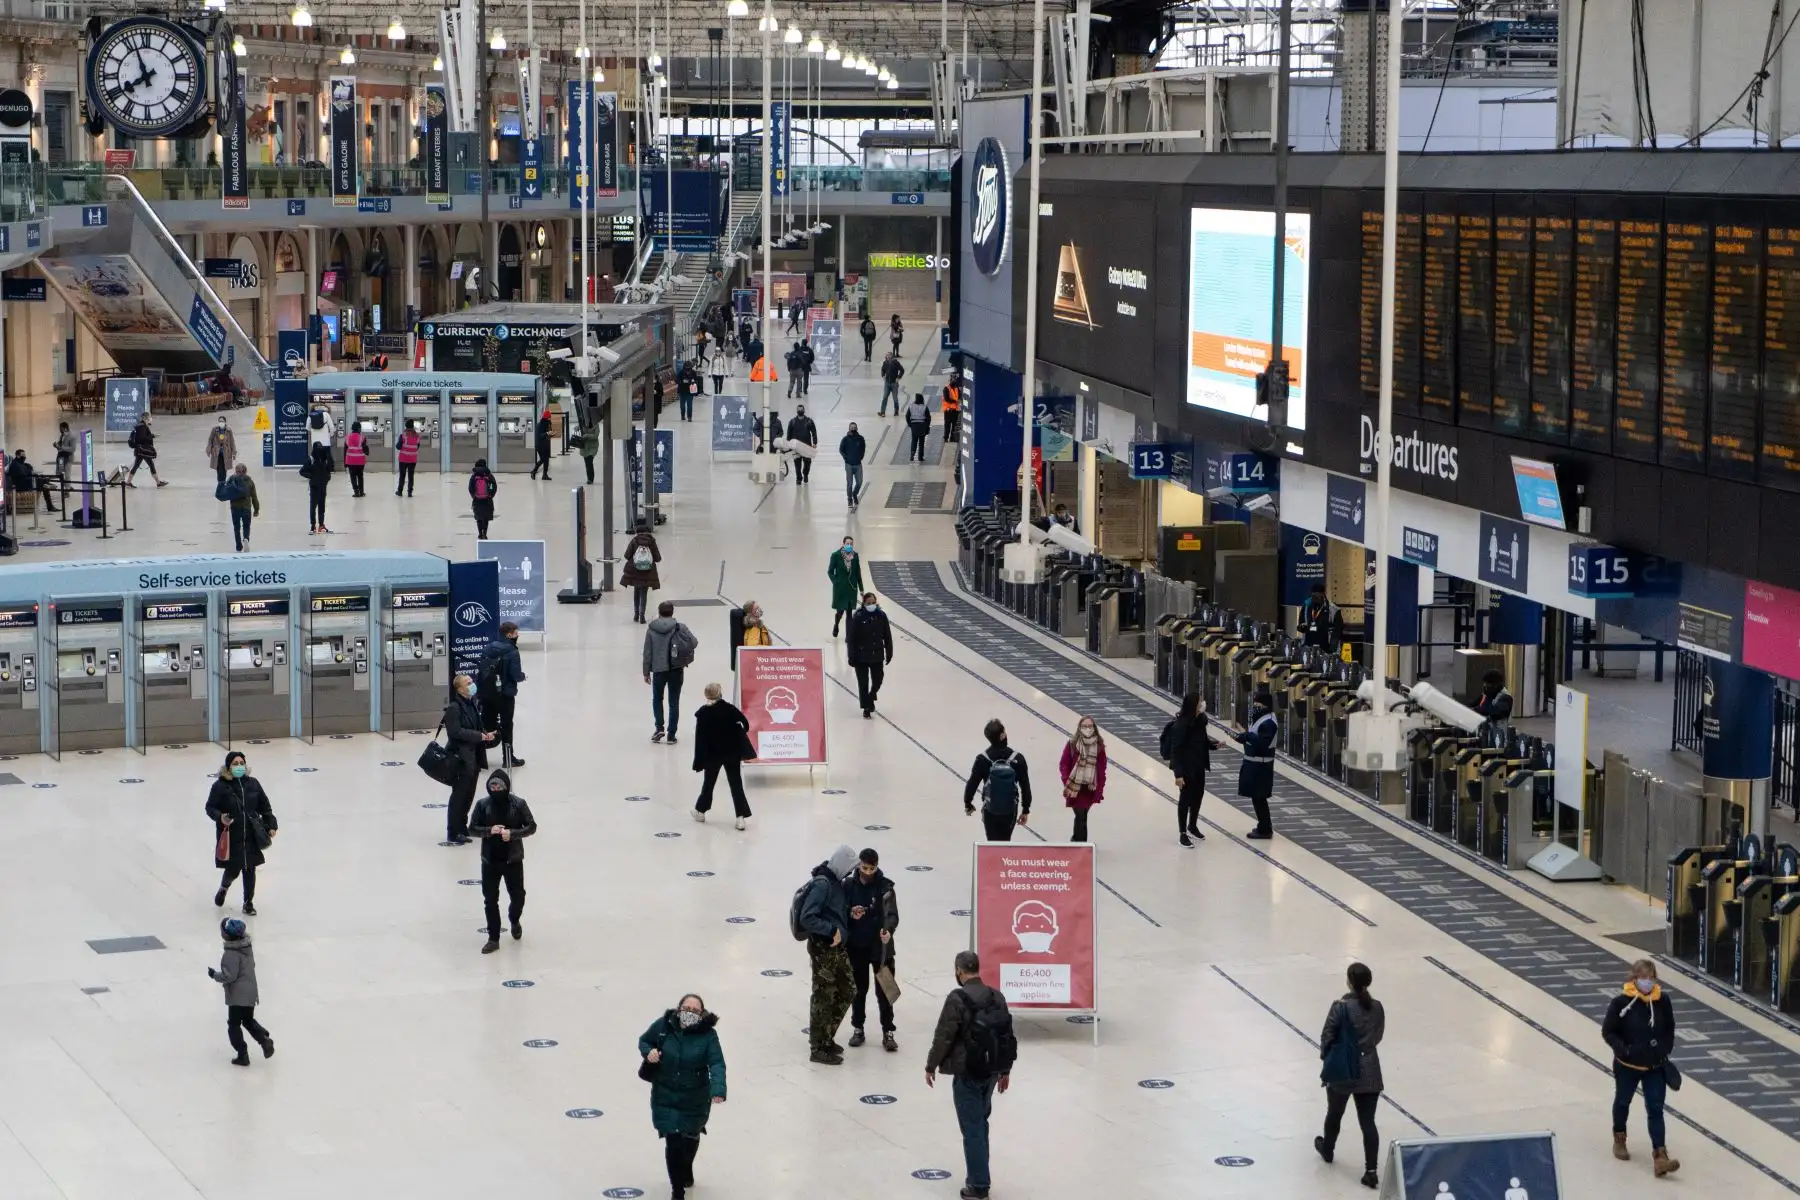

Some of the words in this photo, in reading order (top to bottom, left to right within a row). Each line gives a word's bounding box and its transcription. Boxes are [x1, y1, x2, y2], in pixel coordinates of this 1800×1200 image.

[528, 170, 534, 178] 2
[437, 328, 493, 337] CURRENCY
[510, 328, 566, 337] EXCHANGE
[382, 379, 432, 388] Self-service
[434, 378, 462, 388] tickets
[1139, 451, 1164, 469] 13
[1222, 459, 1231, 480] 14
[1237, 461, 1264, 481] 14
[1571, 556, 1585, 582] 15
[1594, 557, 1629, 583] 15
[139, 571, 231, 588] Self-service
[235, 570, 286, 585] tickets
[500, 609, 531, 617] istance
[1002, 858, 1019, 866] You
[1021, 858, 1045, 866] must
[1008, 870, 1027, 878] face
[1029, 871, 1072, 880] covering,
[1001, 882, 1031, 890] unless
[1033, 883, 1071, 892] exempt.
[1020, 969, 1052, 978] £6,400
[1021, 991, 1051, 999] applies
